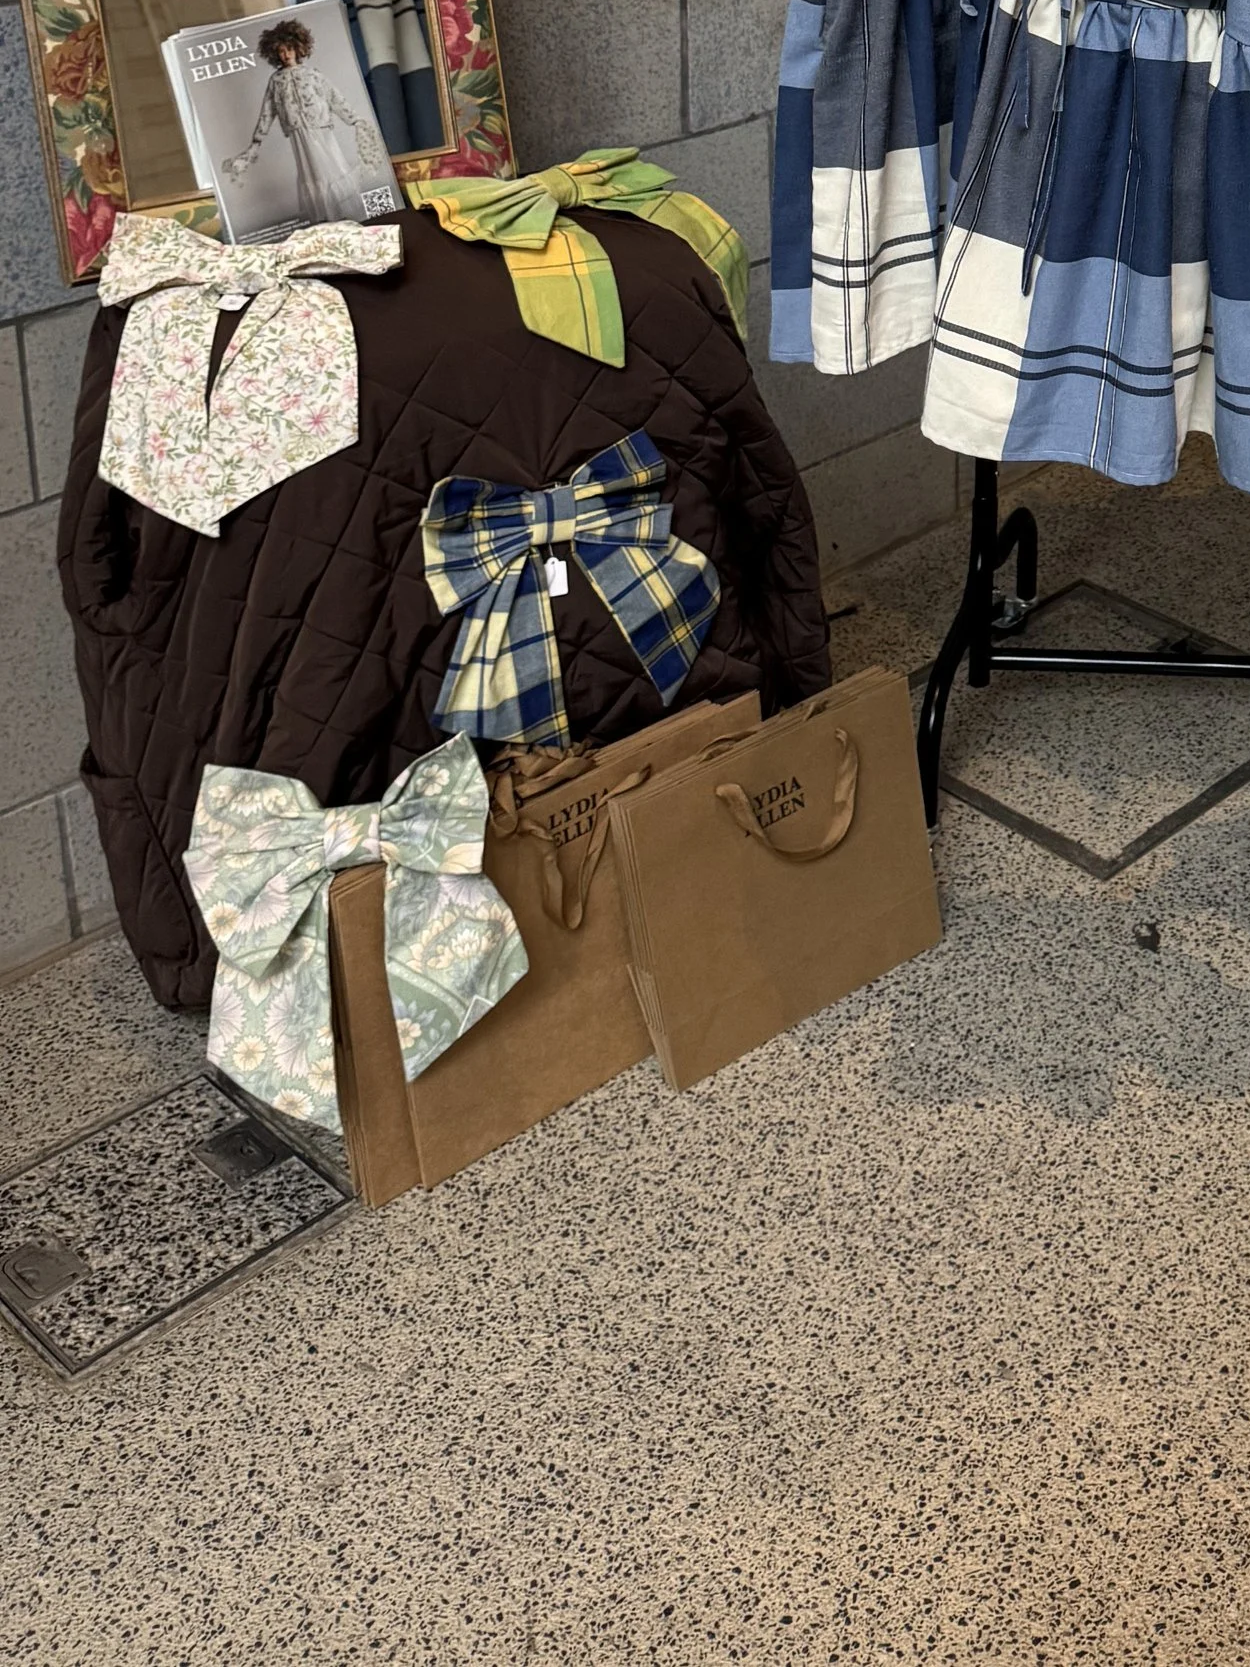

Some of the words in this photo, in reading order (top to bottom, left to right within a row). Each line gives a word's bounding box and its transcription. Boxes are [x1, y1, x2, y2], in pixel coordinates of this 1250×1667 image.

[187, 35, 248, 63] LYDIA
[190, 53, 257, 83] ELLEN
[752, 776, 802, 811] YDIA
[553, 815, 594, 848] ELL
[745, 792, 805, 838] LLEN
